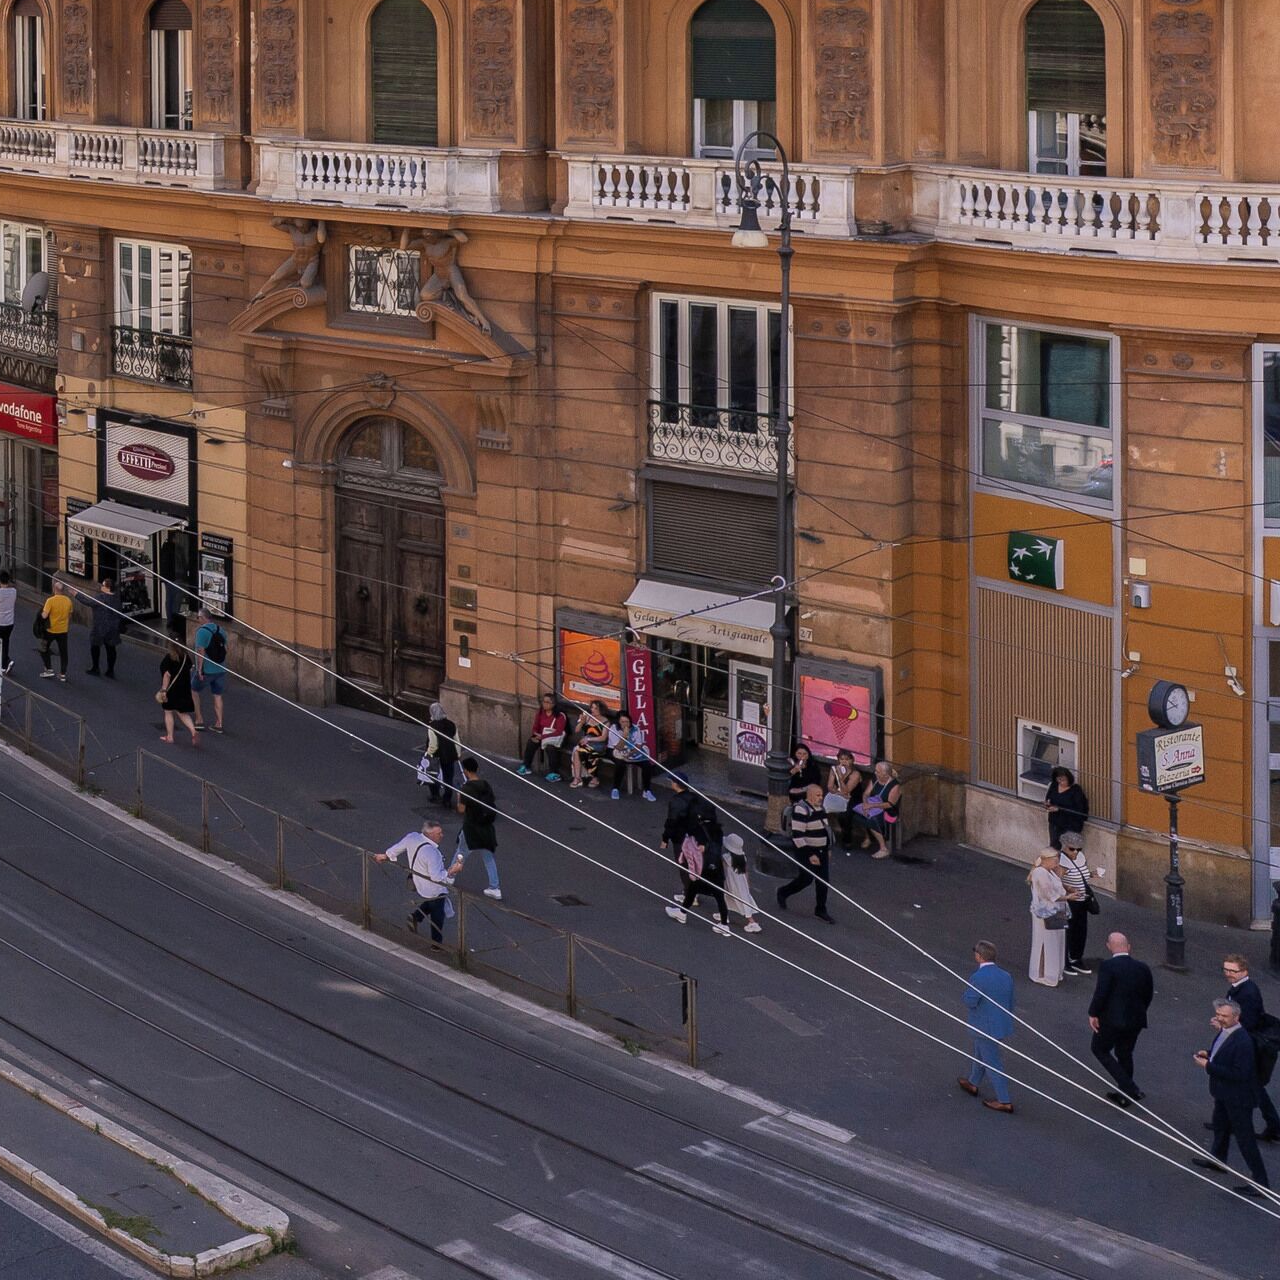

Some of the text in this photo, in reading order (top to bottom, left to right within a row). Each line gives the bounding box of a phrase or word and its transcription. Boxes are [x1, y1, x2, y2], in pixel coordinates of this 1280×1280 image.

[121, 452, 151, 469] EFFETTI
[73, 523, 141, 548] OROLOGERIA
[707, 624, 768, 644] Artigianale
[800, 629, 812, 639] 27
[1156, 731, 1201, 753] Ristorante
[1162, 748, 1196, 767] S. Anna
[1157, 769, 1190, 785] Pizzeria
